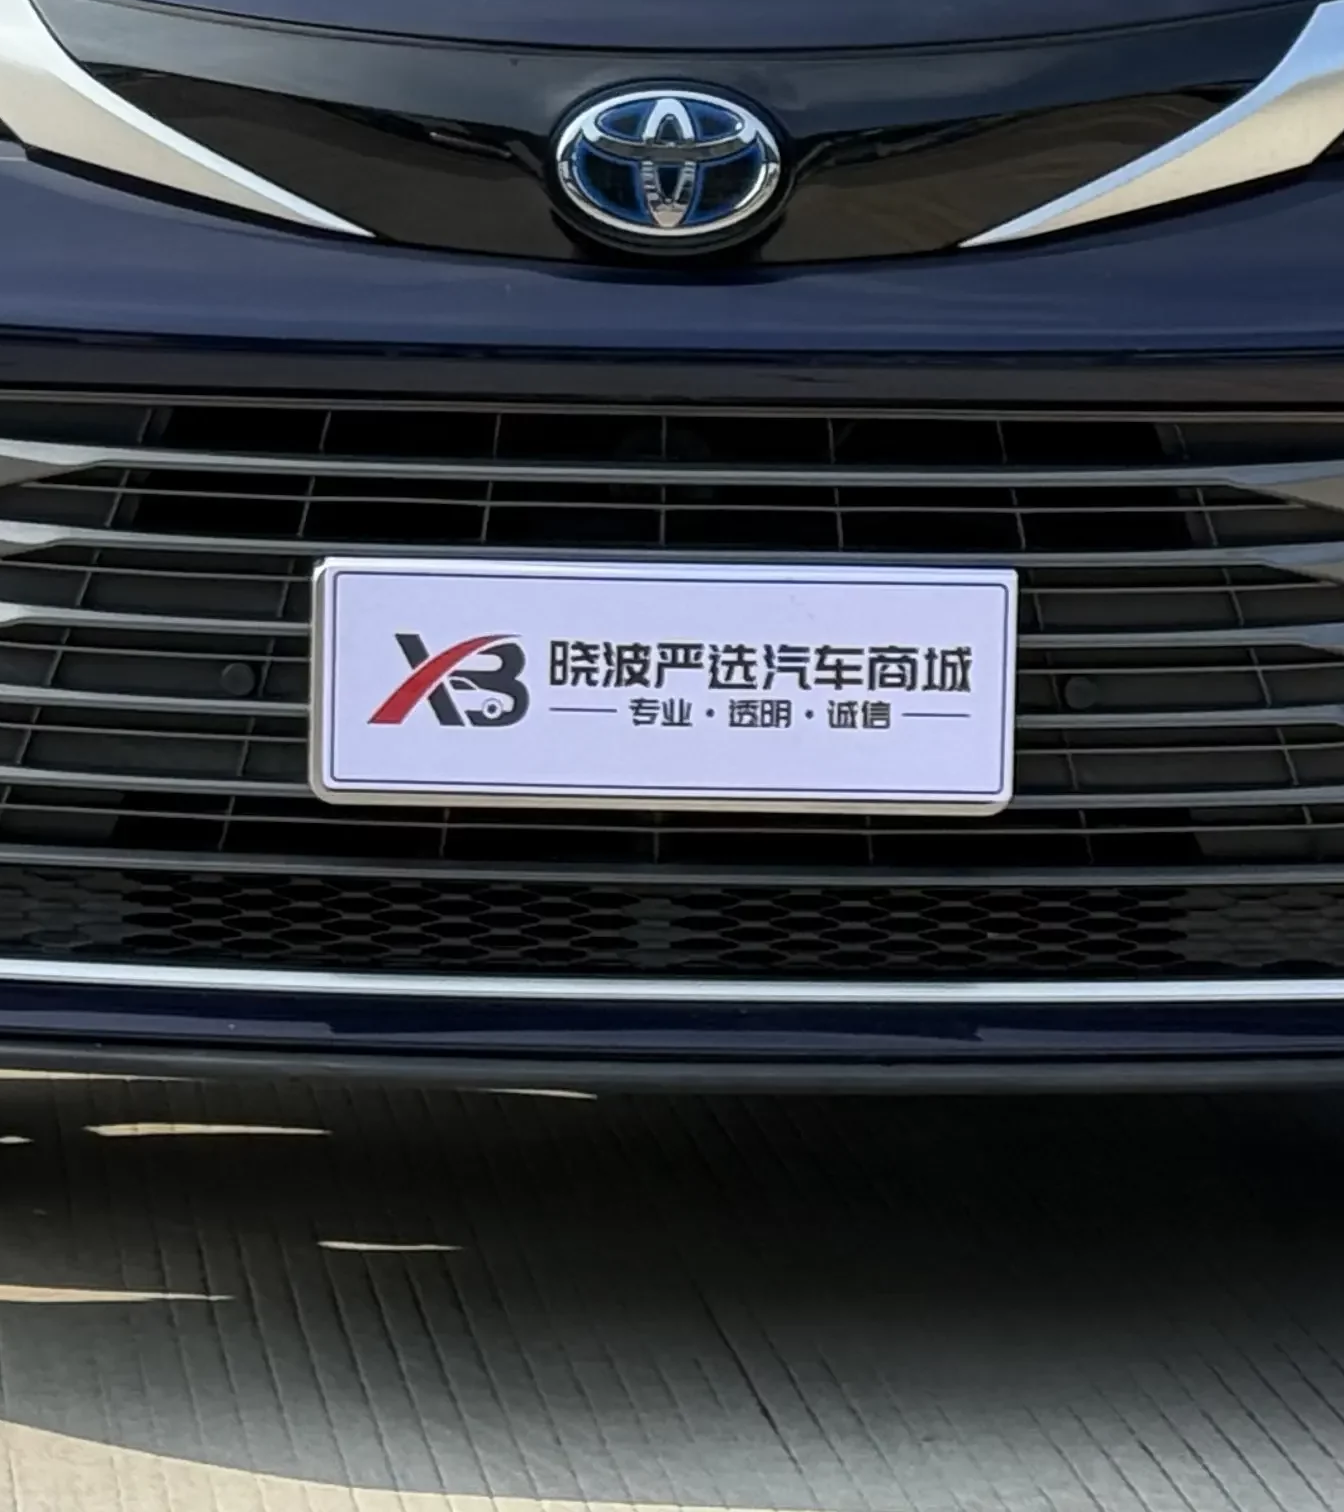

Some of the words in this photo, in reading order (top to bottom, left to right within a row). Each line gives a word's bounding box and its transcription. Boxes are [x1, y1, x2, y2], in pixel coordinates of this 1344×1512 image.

[549, 639, 973, 693] 晓波严选汽车商城
